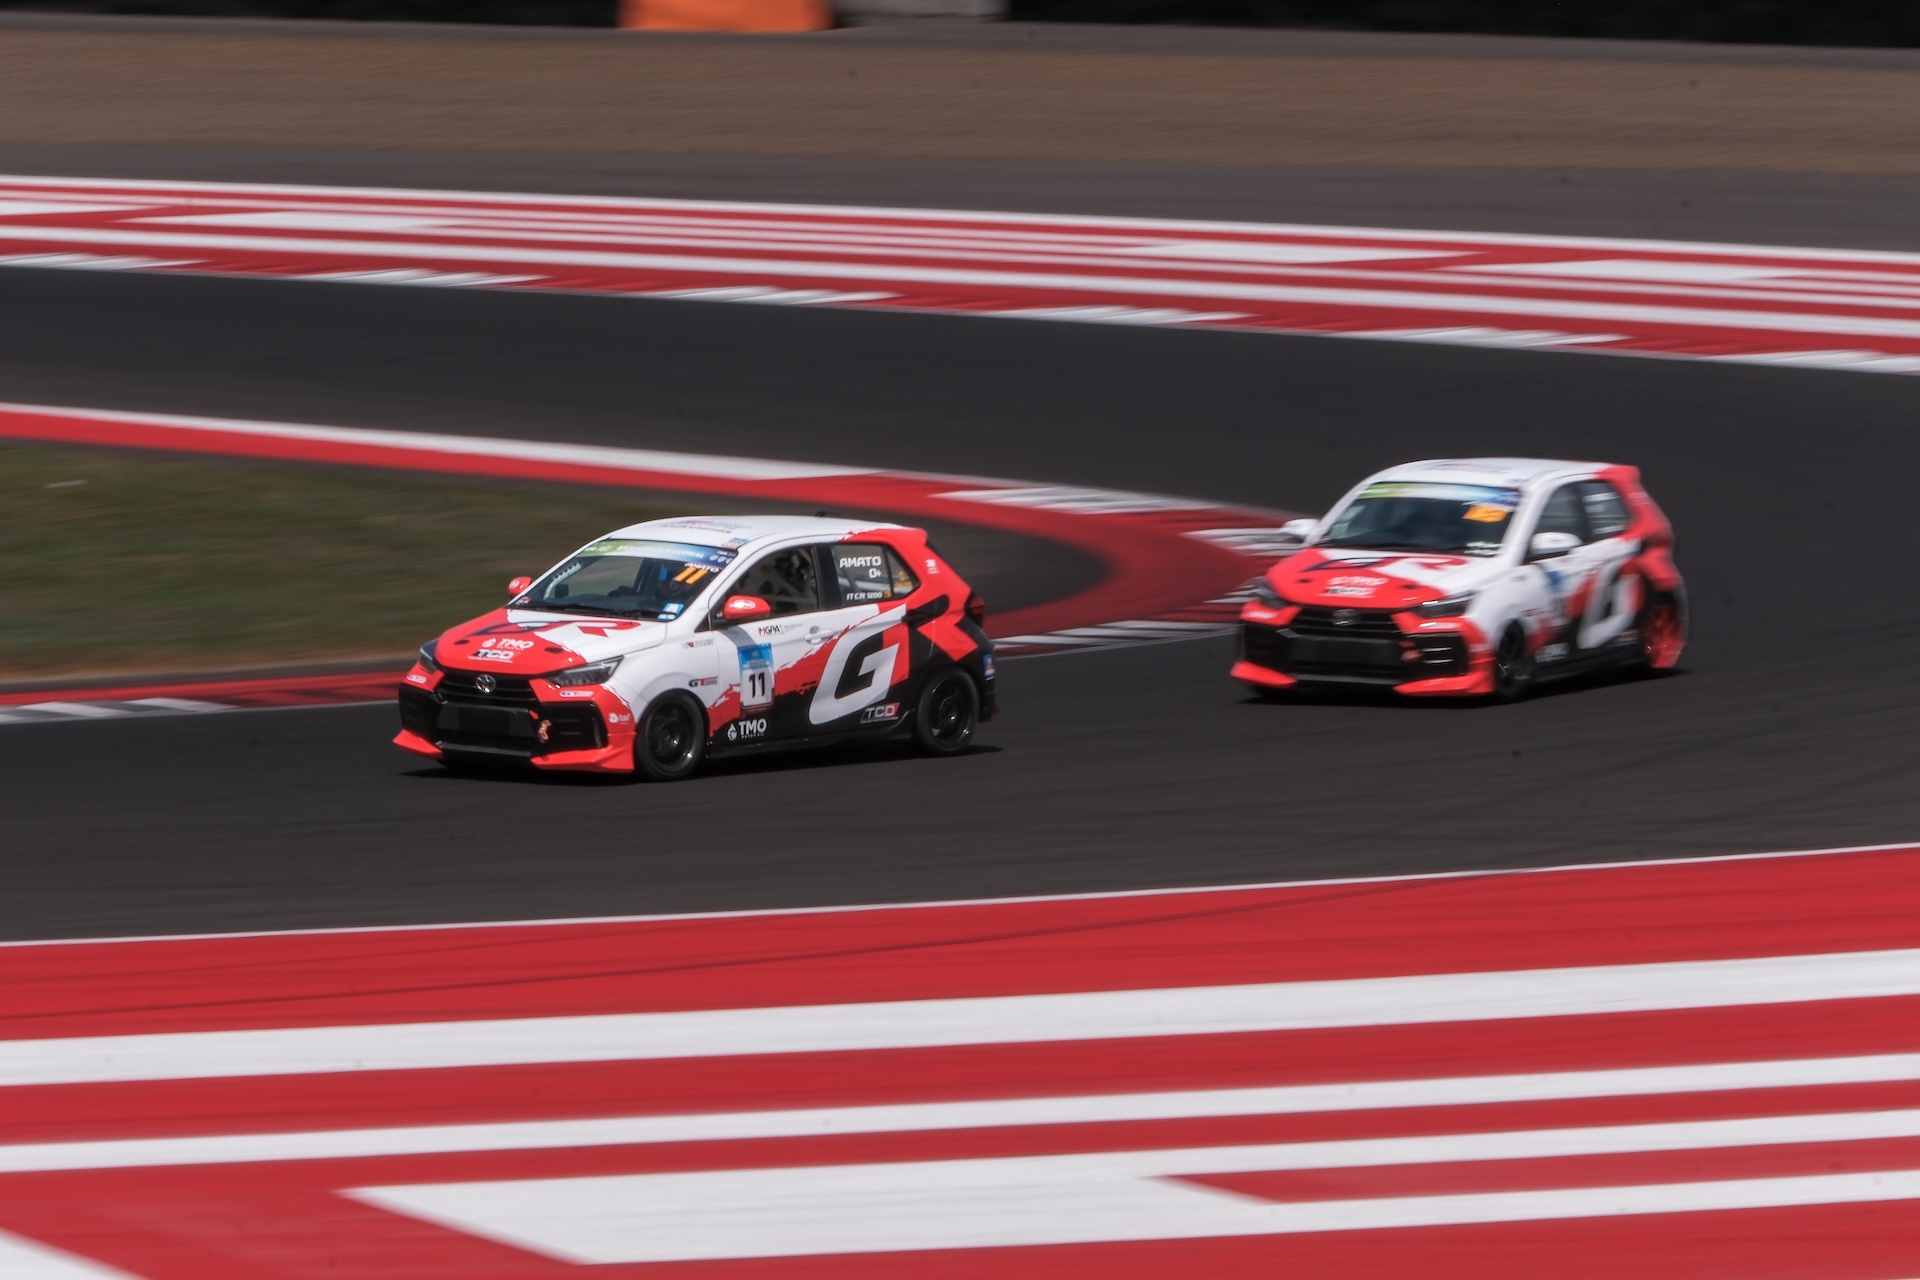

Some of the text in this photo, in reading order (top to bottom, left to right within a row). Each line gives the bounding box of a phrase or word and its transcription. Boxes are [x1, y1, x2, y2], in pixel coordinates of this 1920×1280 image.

[840, 556, 882, 568] AMATO
[674, 567, 709, 585] 11
[866, 591, 883, 600] 1200
[498, 638, 535, 649] TMO
[478, 648, 515, 660] TCD
[808, 602, 907, 725] G
[749, 672, 766, 699] 11
[866, 704, 896, 719] TCD
[739, 718, 767, 735] TMO
